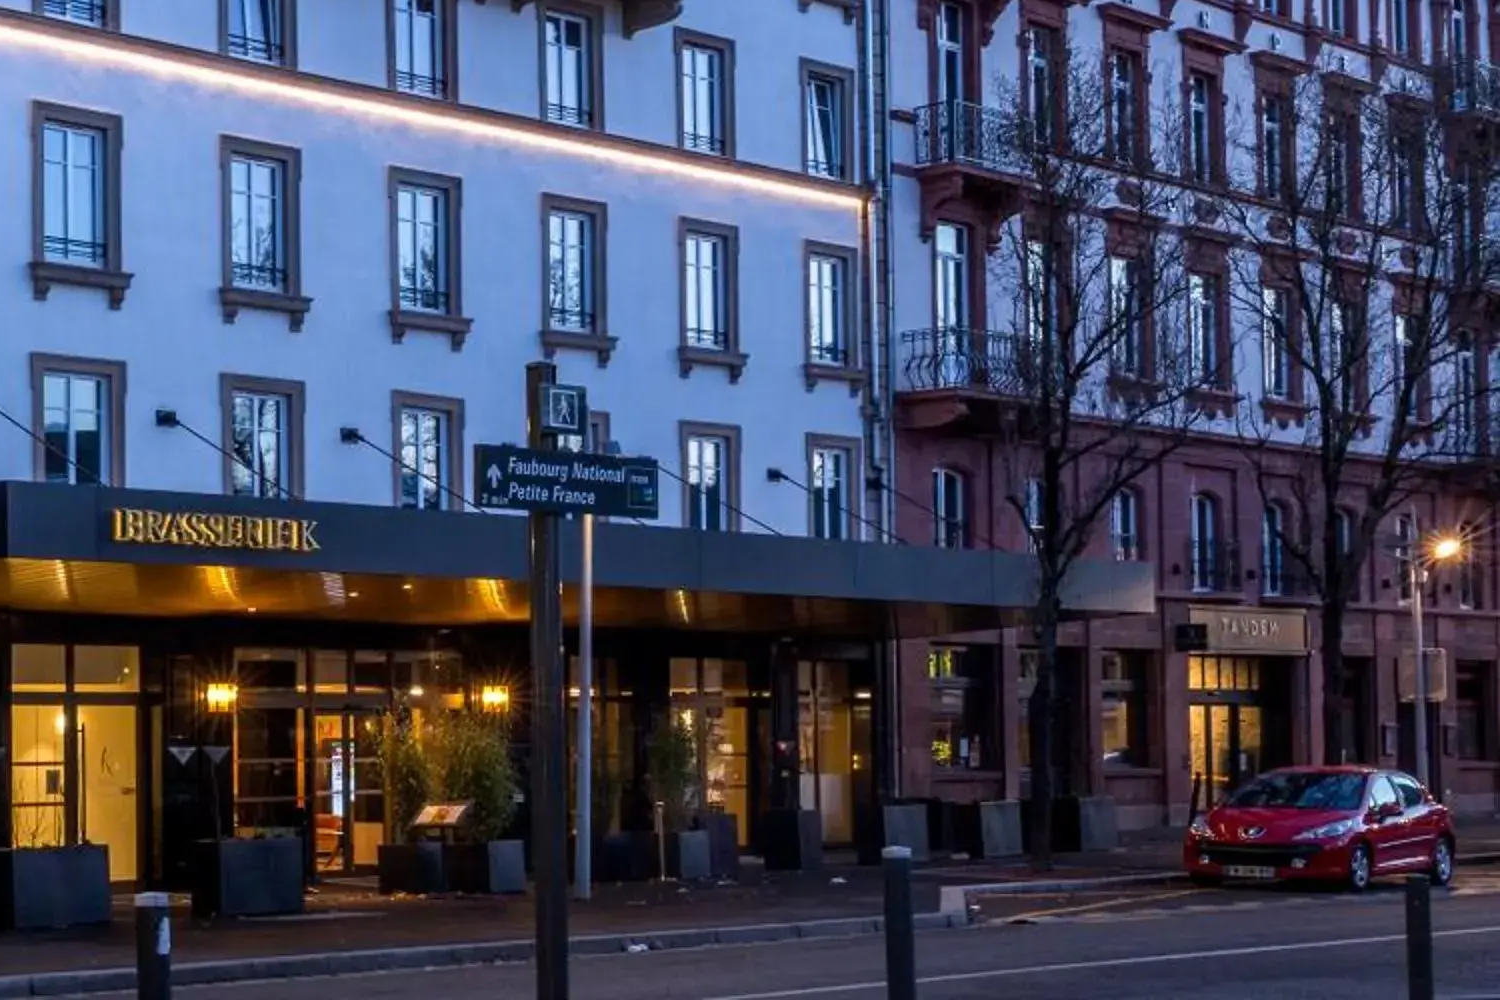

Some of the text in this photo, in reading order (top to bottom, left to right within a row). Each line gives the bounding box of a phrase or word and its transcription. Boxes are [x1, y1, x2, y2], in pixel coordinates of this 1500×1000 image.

[508, 456, 569, 483] Faubourg
[572, 461, 625, 483] National
[508, 481, 596, 505] Petite France
[113, 507, 291, 548] BRASSERIE
